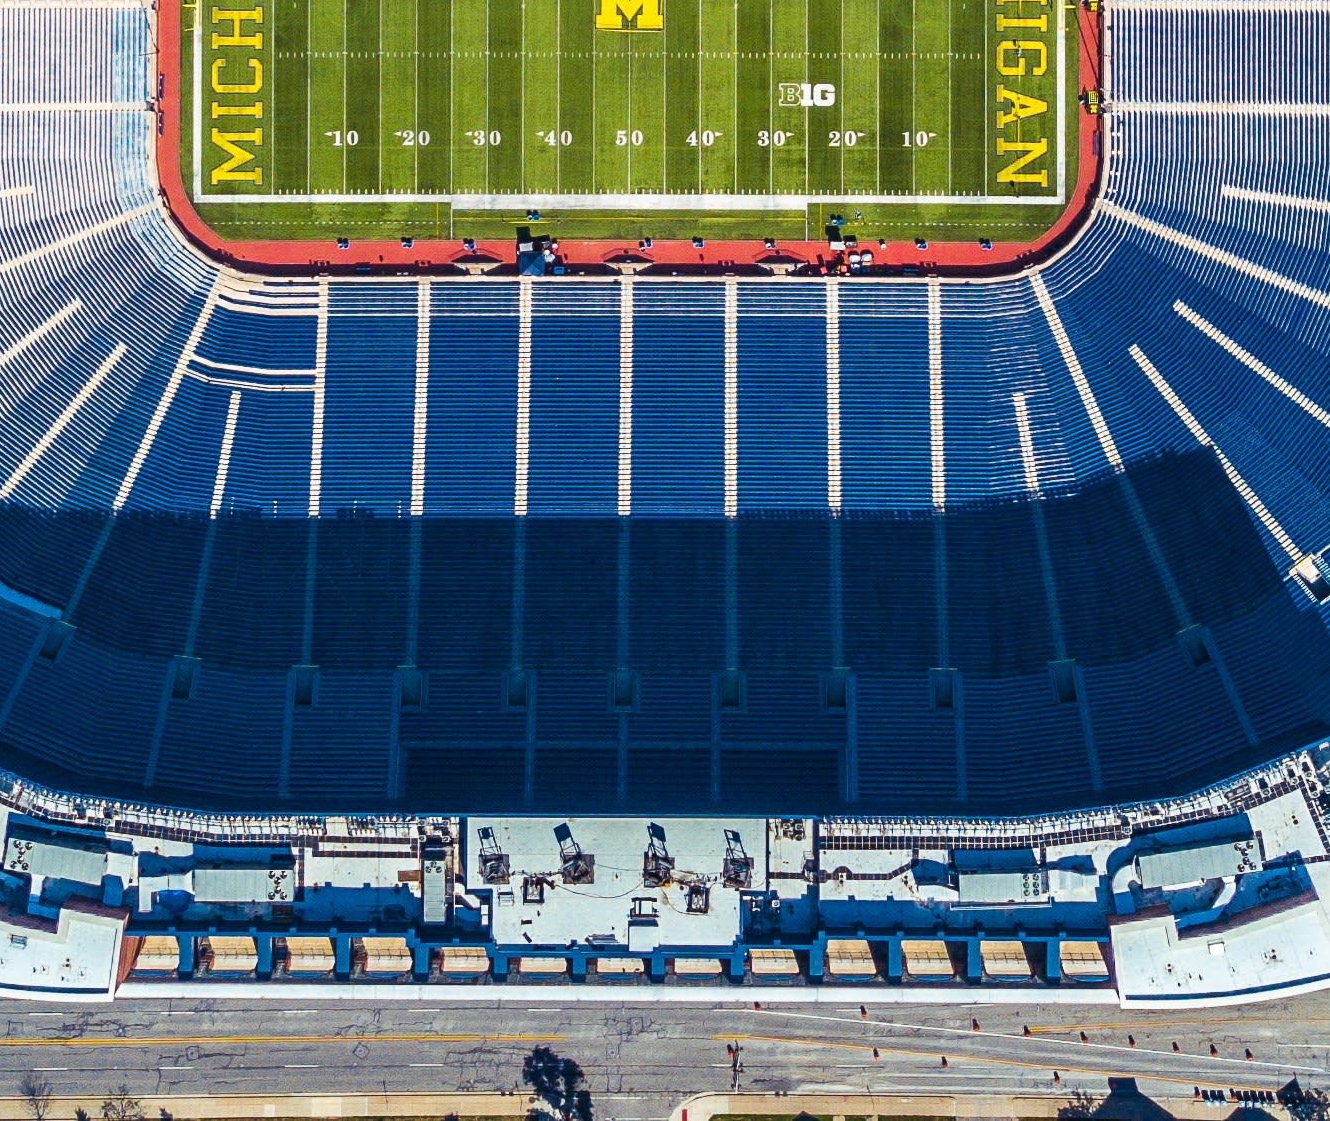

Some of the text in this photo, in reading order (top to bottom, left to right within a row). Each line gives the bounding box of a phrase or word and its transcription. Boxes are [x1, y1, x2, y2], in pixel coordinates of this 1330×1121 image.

[332, 130, 358, 146] 10
[402, 130, 430, 146] 20
[474, 130, 501, 146] 30
[545, 130, 572, 146] 40
[616, 130, 643, 146] 50
[686, 130, 714, 146] 40
[758, 130, 785, 146] 30
[829, 130, 856, 146] 20
[902, 130, 927, 146] 10
